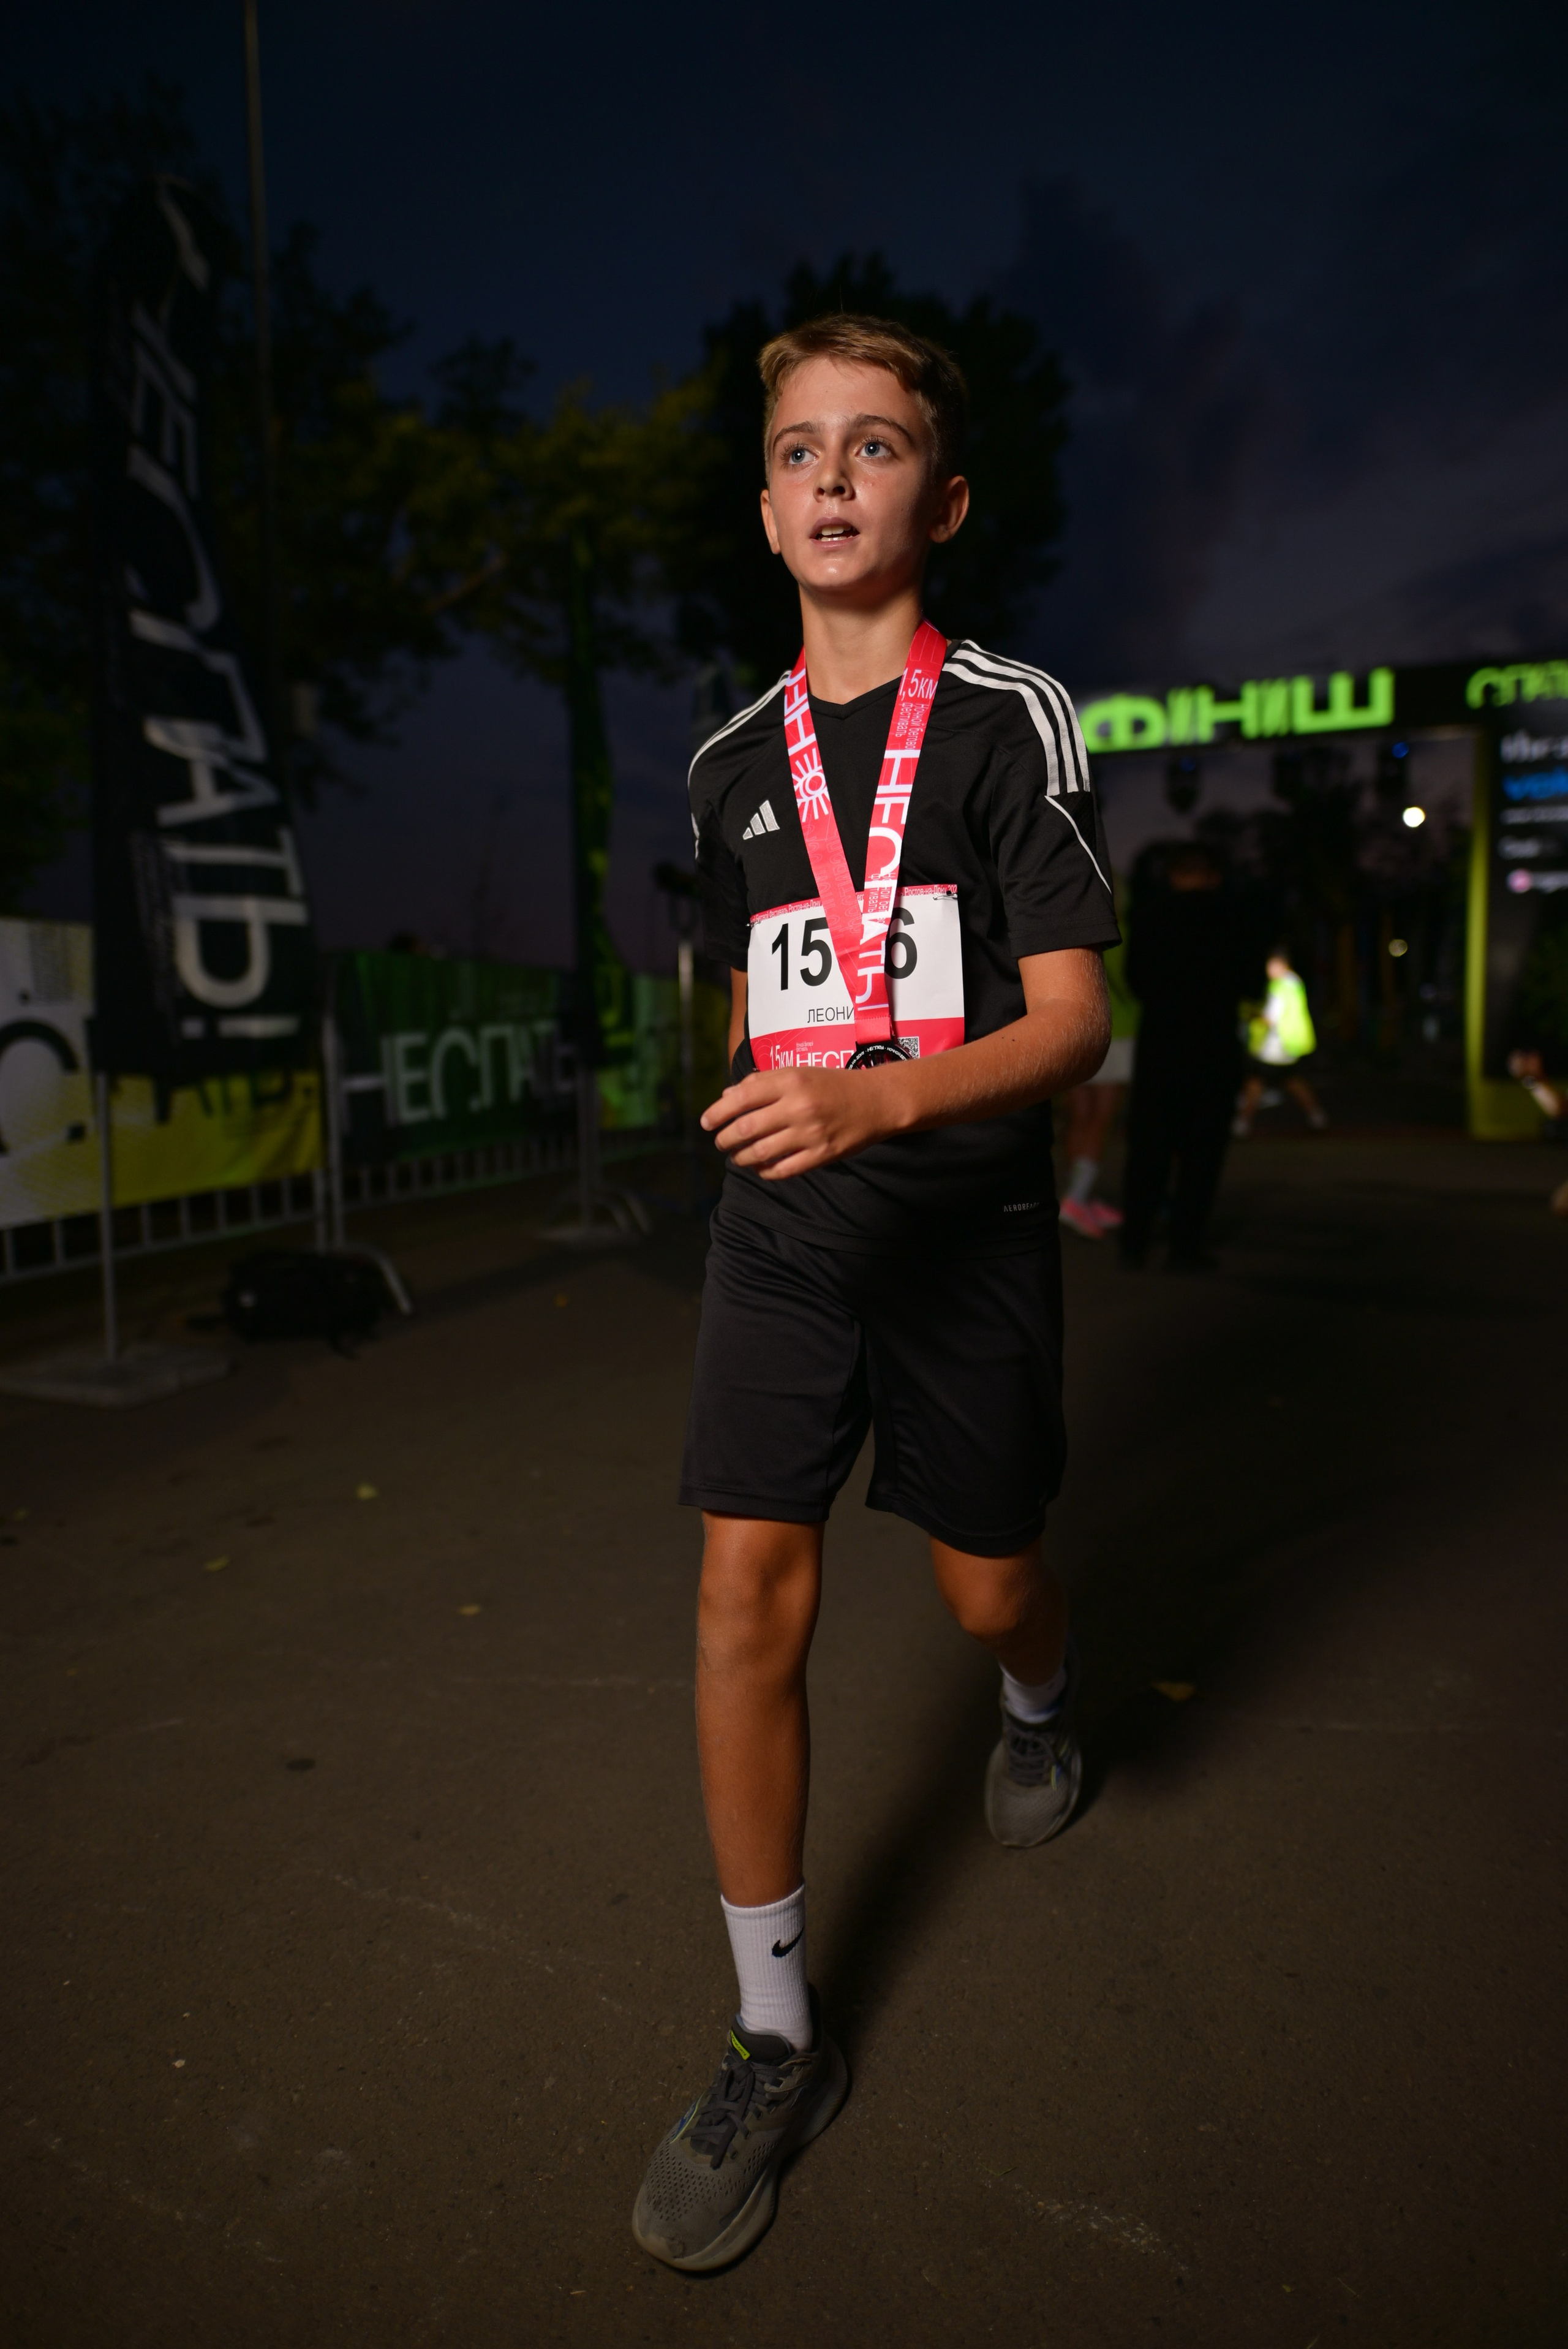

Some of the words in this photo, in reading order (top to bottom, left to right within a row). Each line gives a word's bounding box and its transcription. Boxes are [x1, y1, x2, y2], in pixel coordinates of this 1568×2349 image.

[895, 703, 913, 738] фестиваль
[905, 727, 923, 750] бегово
[905, 885, 946, 896] Ростов-на-Дону
[772, 907, 918, 991] 156
[807, 1006, 854, 1023] ЛЕОНИ
